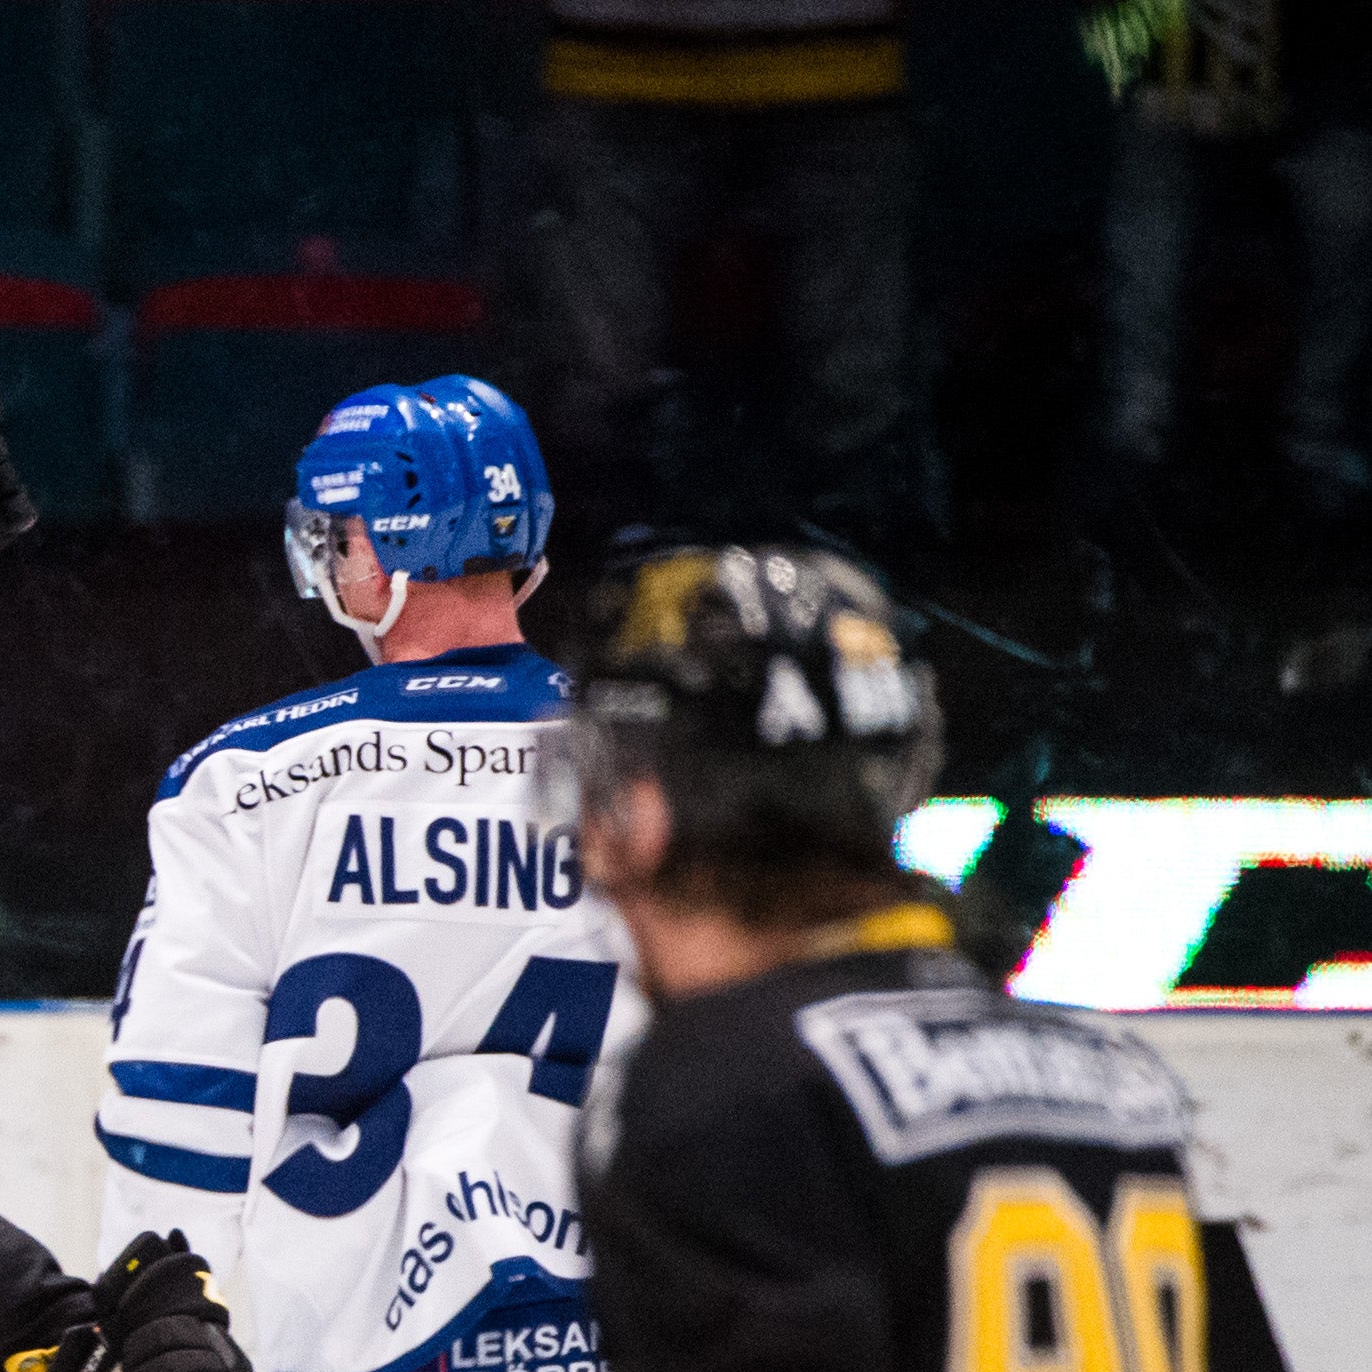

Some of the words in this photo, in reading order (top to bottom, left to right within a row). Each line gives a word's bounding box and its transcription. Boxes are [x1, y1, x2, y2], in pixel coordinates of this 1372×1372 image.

[483, 463, 522, 503] 34
[373, 513, 431, 532] CCM
[404, 674, 504, 692] CCM
[424, 730, 538, 785] Spar
[327, 814, 584, 912] ALSING
[258, 952, 619, 1218] 34
